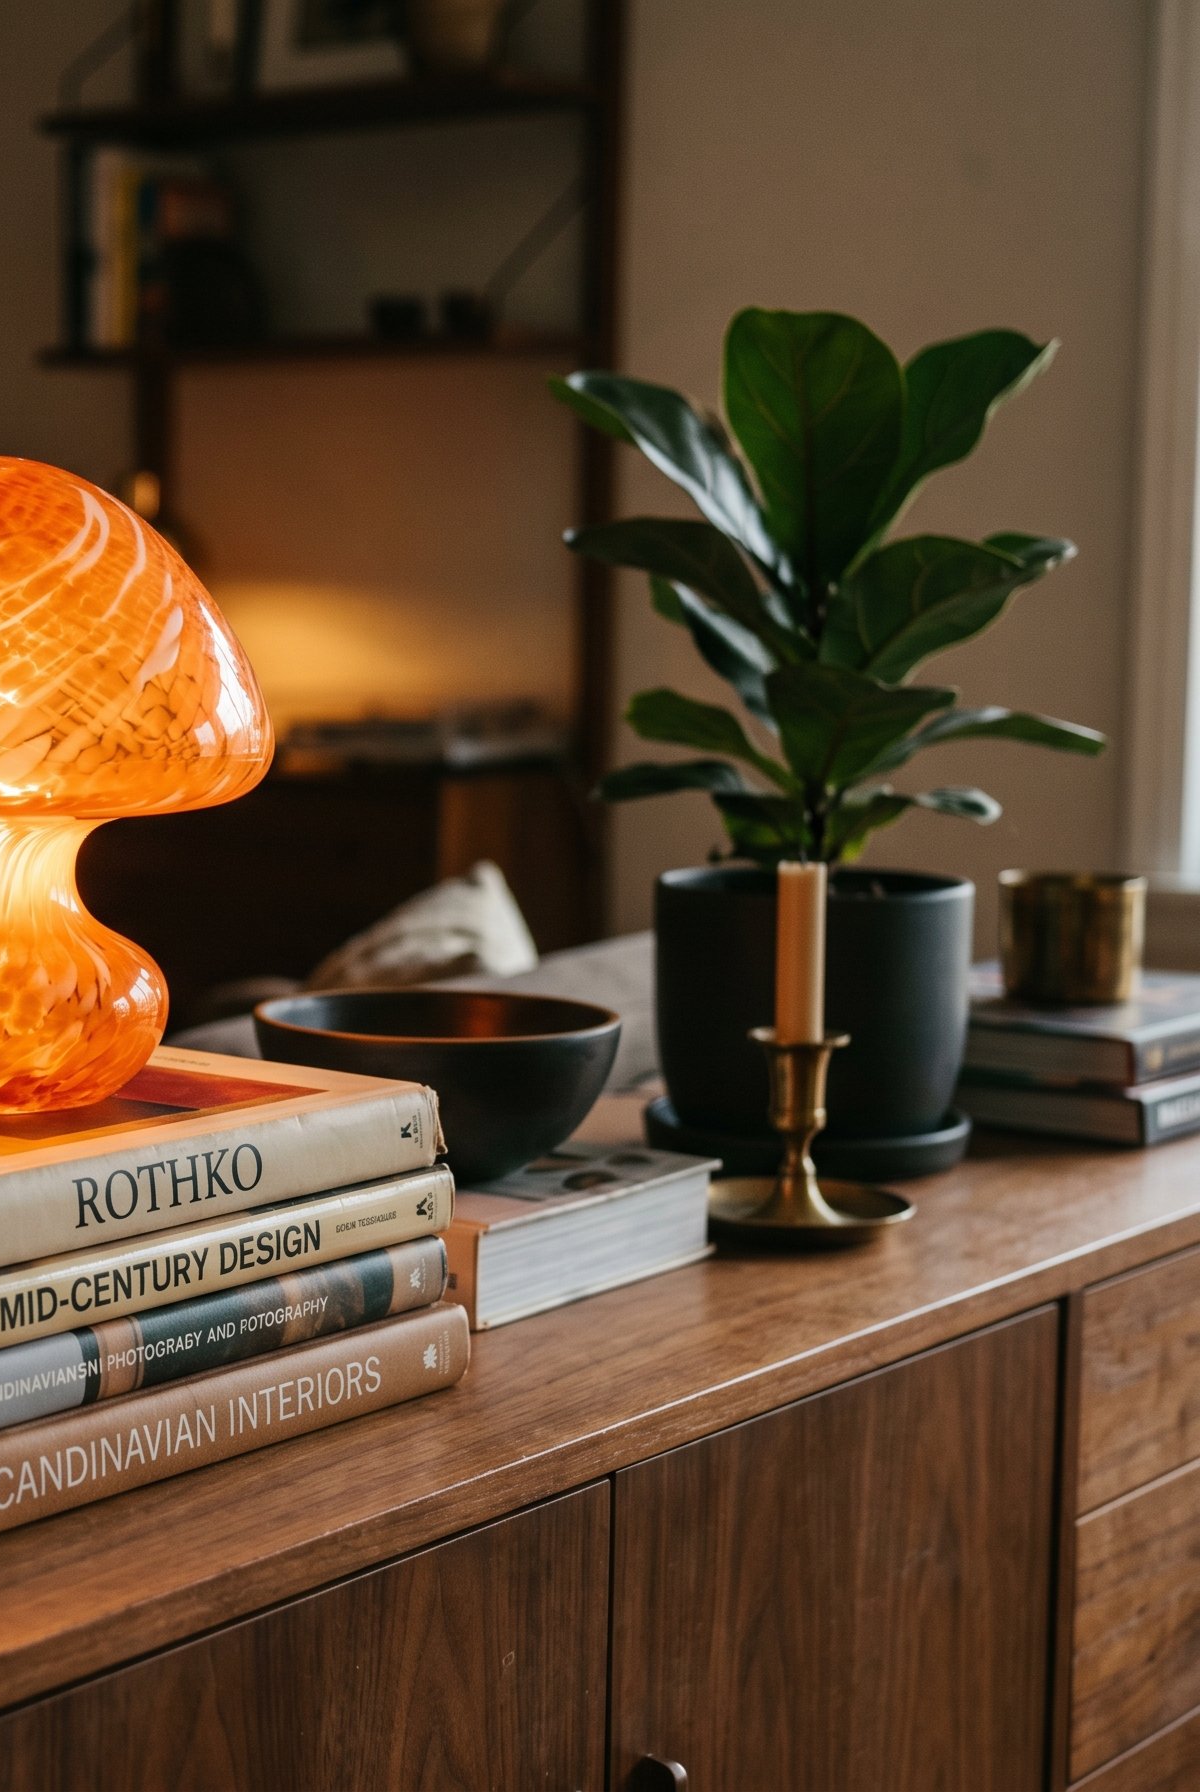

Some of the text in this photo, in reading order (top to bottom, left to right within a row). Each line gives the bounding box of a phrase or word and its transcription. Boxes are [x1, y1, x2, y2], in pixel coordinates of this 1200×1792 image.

[72, 1143, 263, 1229] ROTHKO
[0, 1248, 209, 1332] MID-CENTURY
[219, 1220, 321, 1275] DESIGN
[207, 1322, 236, 1344] AND
[229, 1356, 383, 1437] INTERIORS
